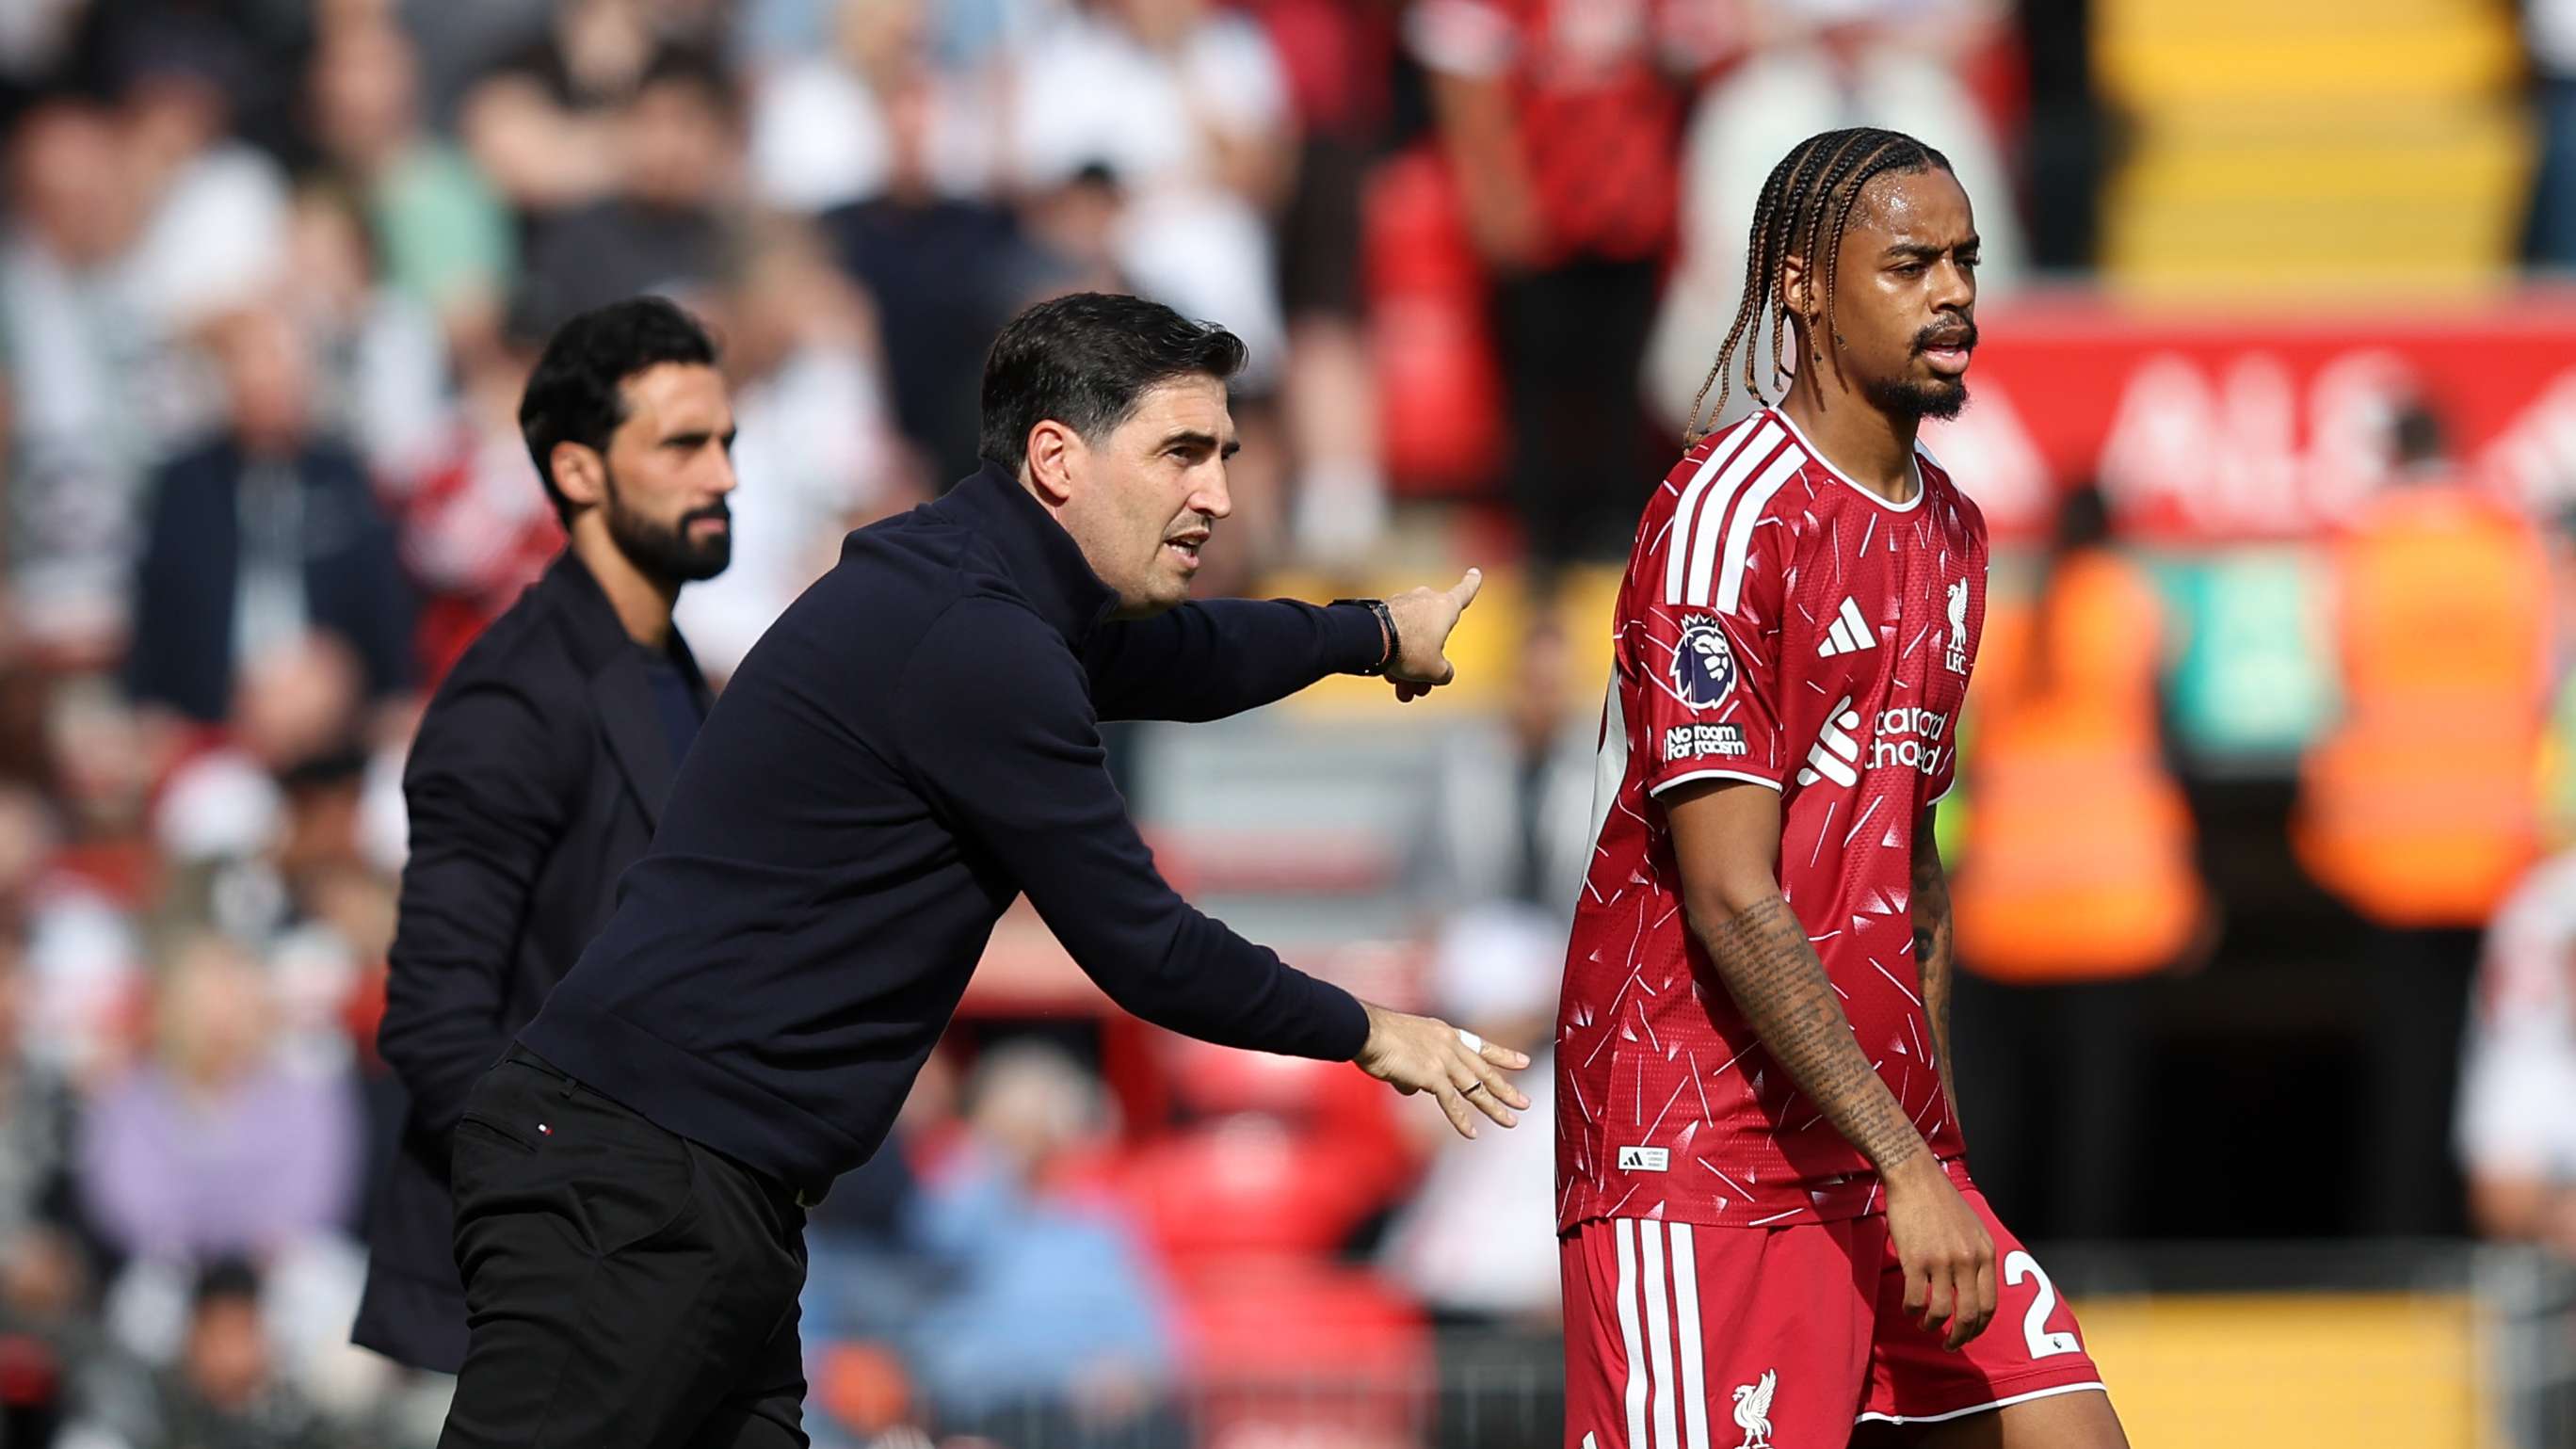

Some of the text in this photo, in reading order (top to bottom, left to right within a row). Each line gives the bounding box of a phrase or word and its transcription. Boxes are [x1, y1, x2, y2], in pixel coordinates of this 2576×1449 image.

[1666, 725, 1736, 744] No room
[2004, 1250, 2081, 1360] 2
